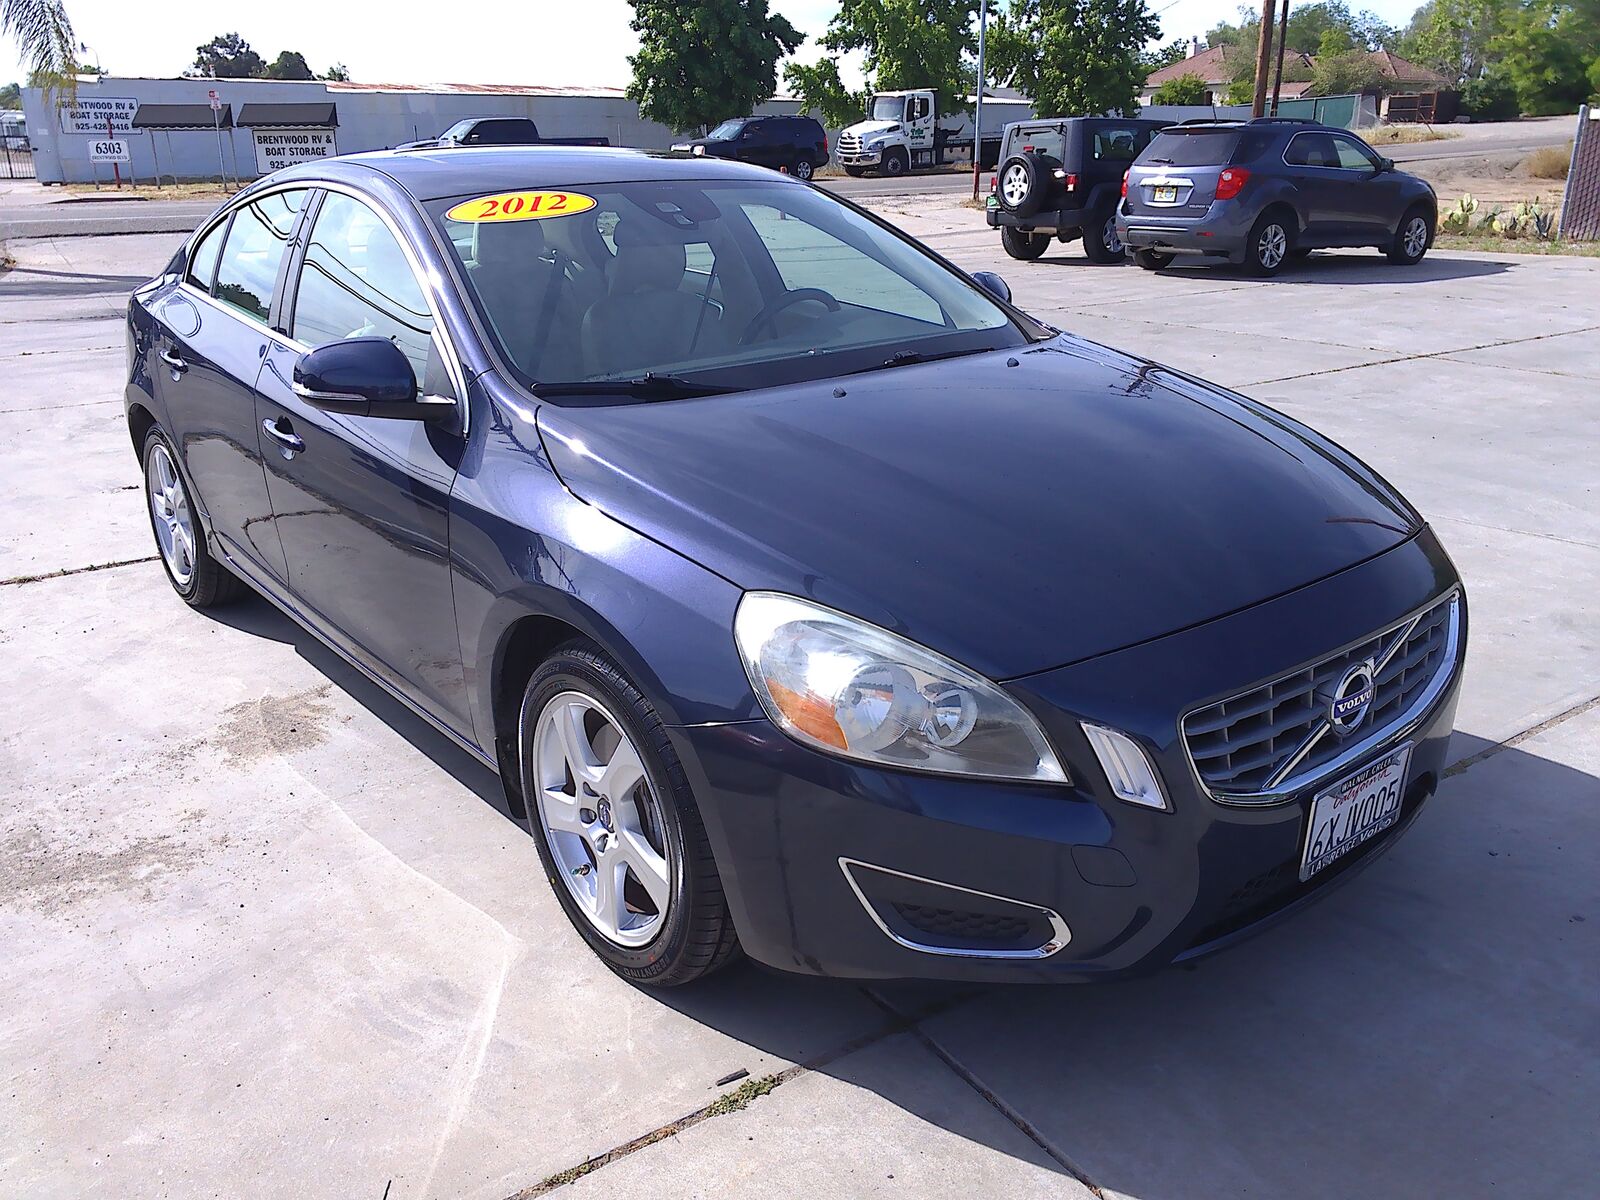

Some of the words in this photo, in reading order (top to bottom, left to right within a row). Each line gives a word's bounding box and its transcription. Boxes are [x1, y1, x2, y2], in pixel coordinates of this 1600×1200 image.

[62, 102, 112, 110] RNTWOOD
[70, 111, 90, 119] BOAT
[94, 112, 130, 120] STORAGE
[257, 135, 308, 144] BRENTWOOD
[312, 135, 322, 144] RV
[326, 135, 332, 143] &
[95, 142, 122, 154] 6303
[265, 147, 286, 156] BOAT
[289, 147, 327, 156] STORAGE
[478, 195, 567, 218] 2012
[1337, 690, 1371, 712] VOLVO
[1310, 777, 1399, 860] 6XJV005
[1310, 838, 1357, 876] LARENCE
